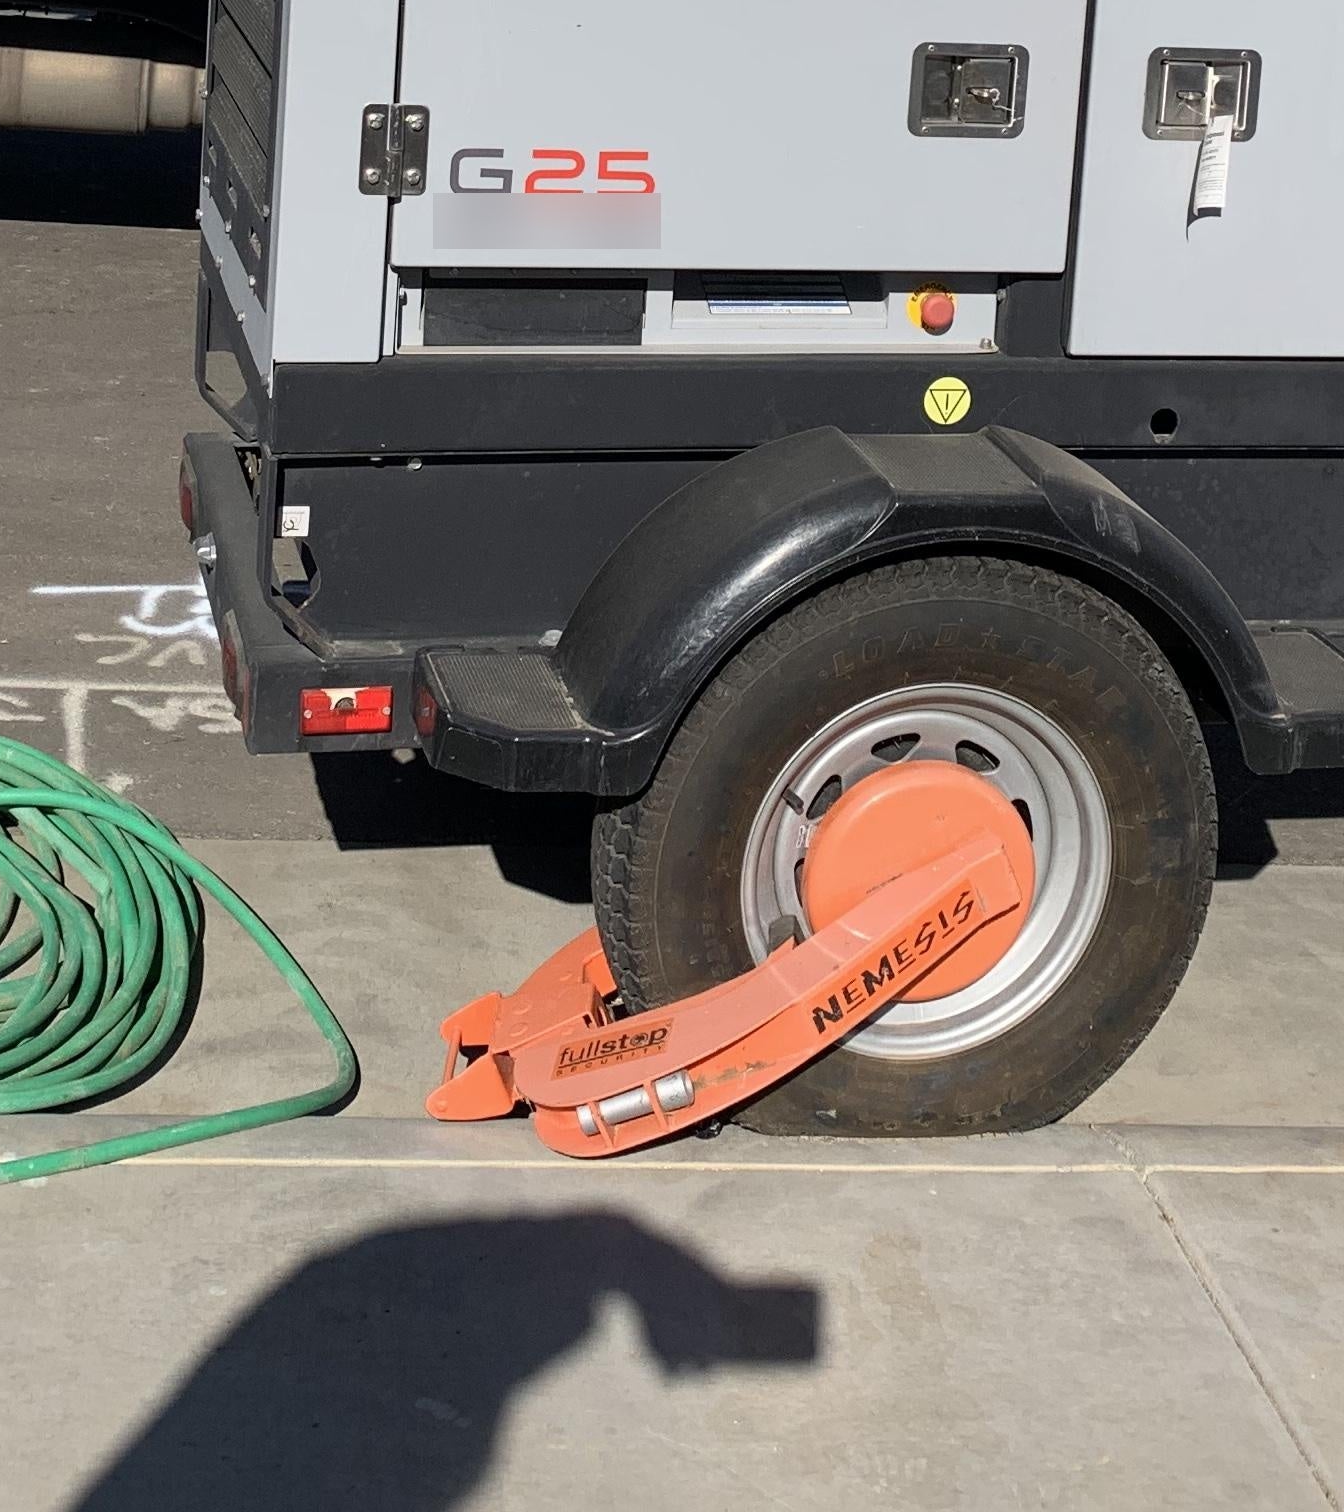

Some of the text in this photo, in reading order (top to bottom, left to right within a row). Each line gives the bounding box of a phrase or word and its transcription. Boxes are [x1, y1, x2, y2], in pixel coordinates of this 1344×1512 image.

[450, 148, 655, 193] G25
[811, 889, 975, 1035] NEMESIS
[559, 1027, 669, 1065] fullstop
